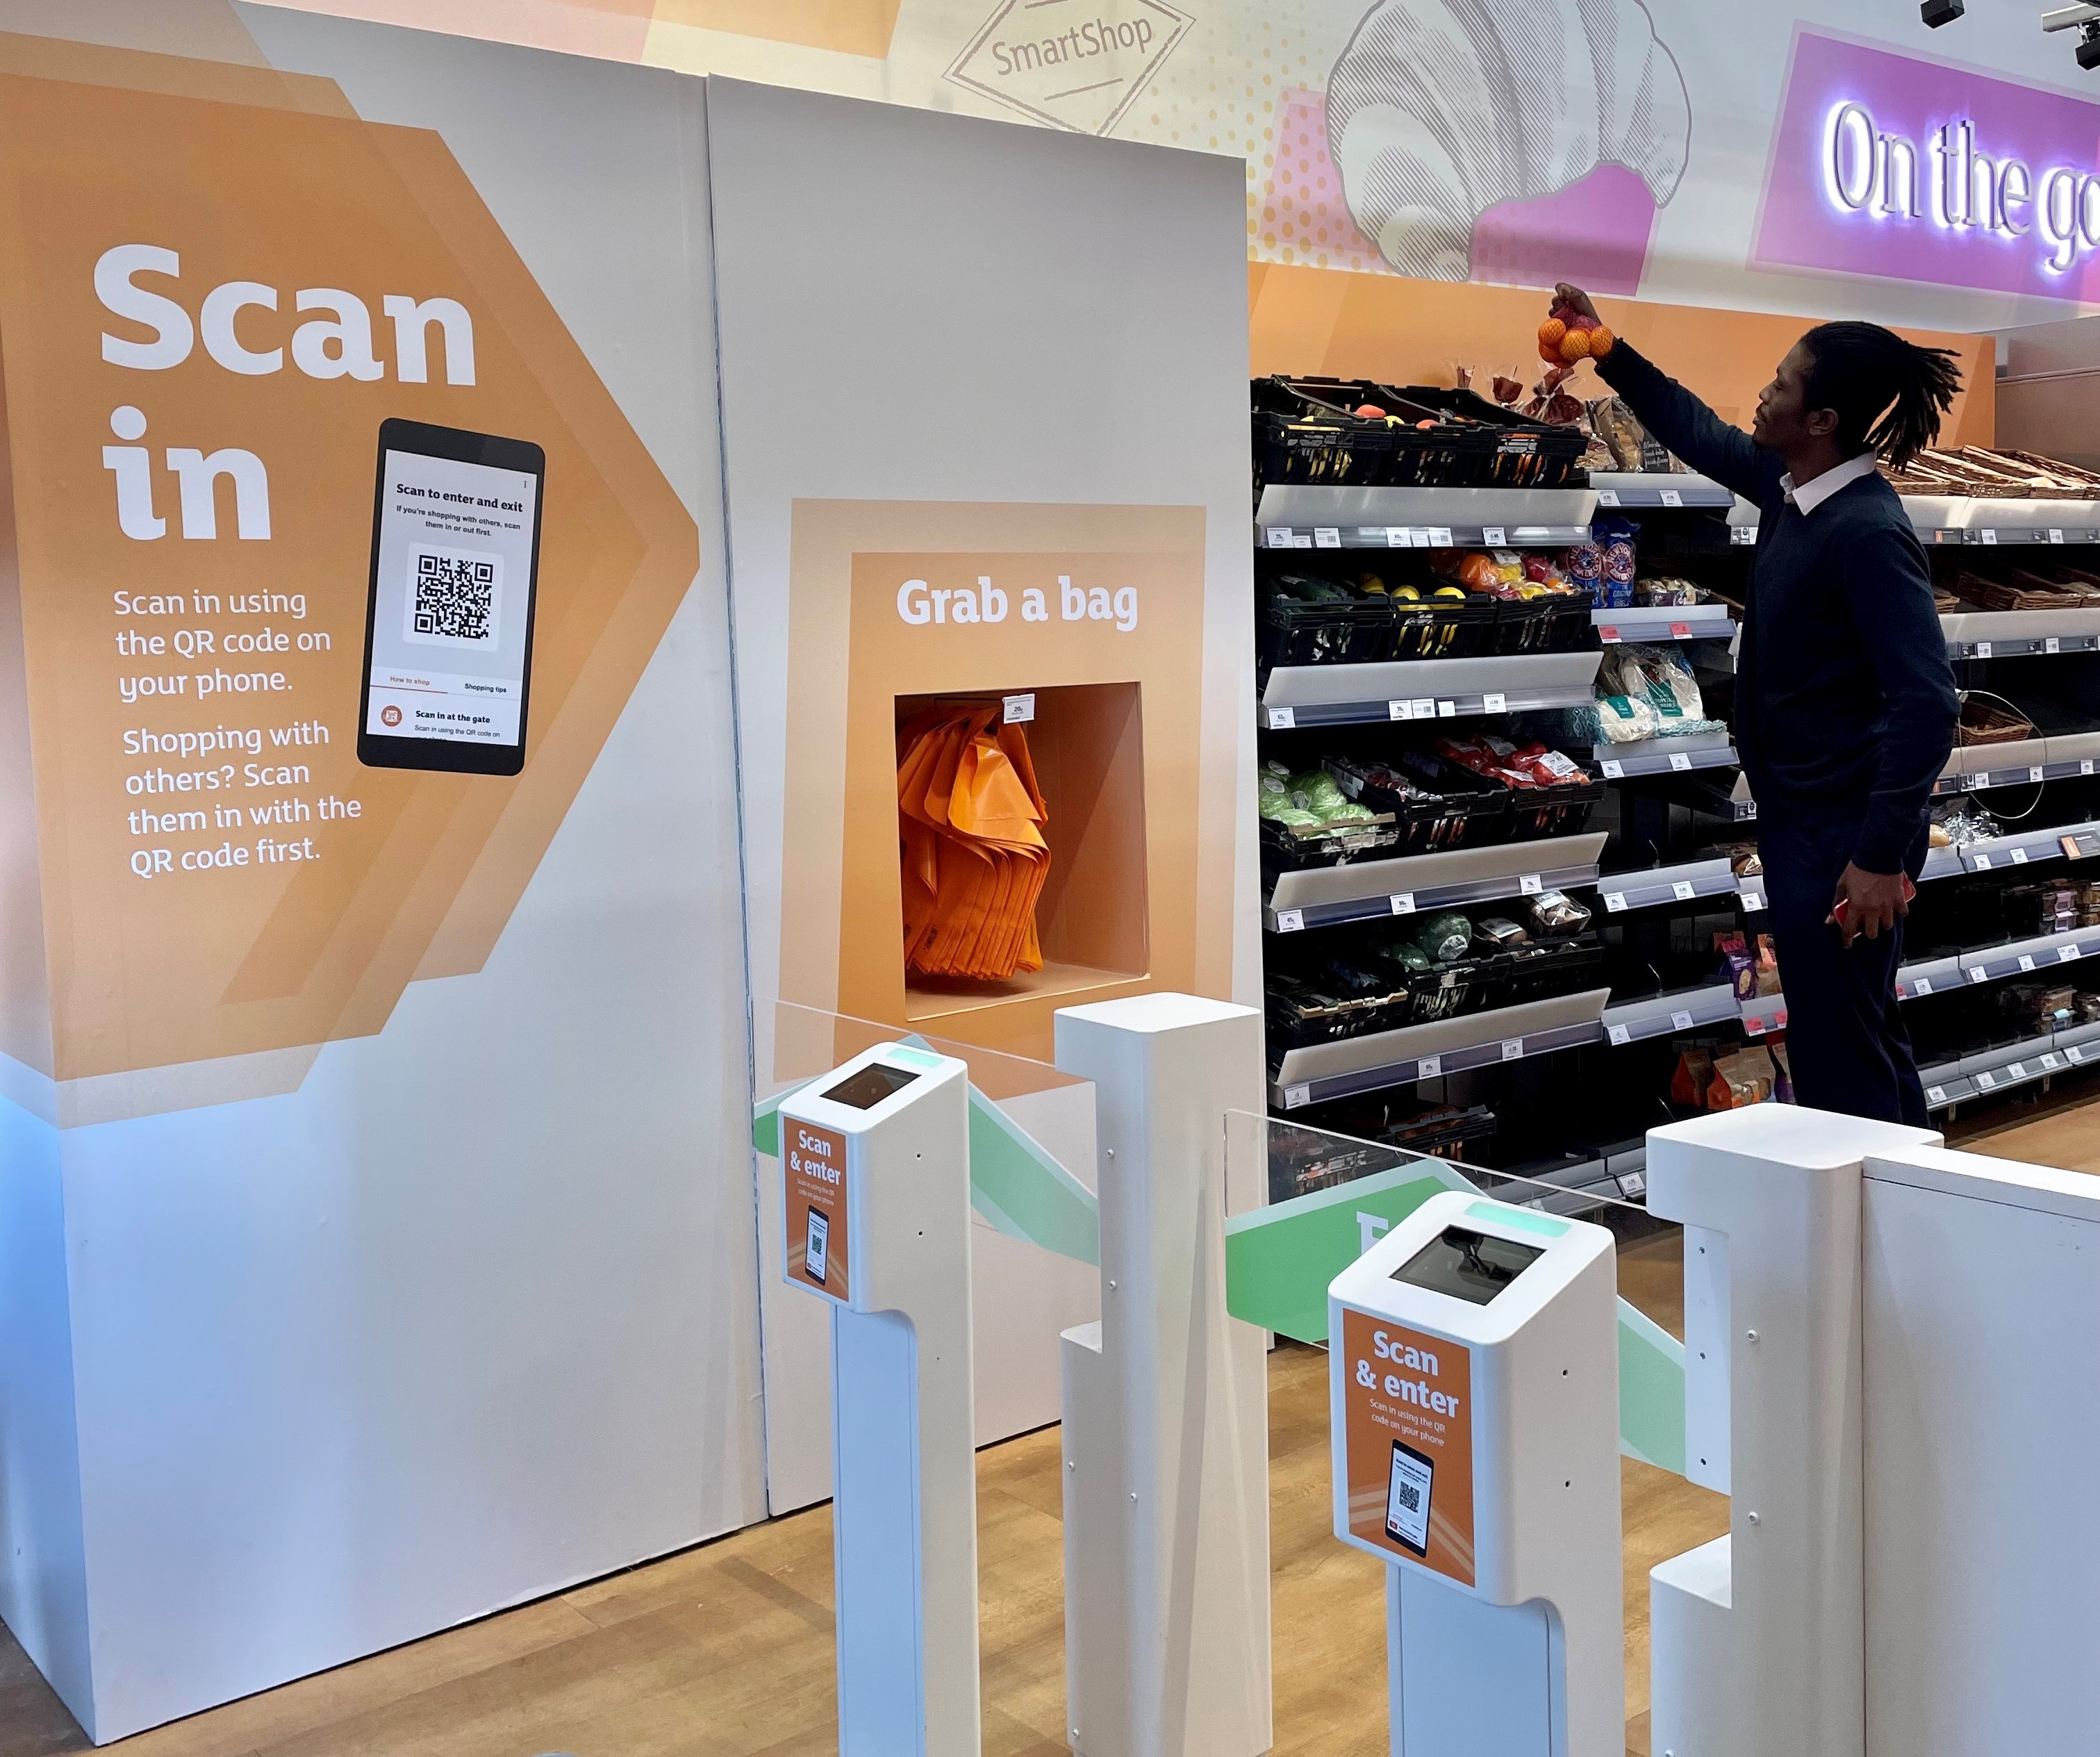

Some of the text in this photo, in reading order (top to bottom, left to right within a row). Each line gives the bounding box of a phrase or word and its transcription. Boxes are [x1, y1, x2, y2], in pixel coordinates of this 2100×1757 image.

[992, 18, 1152, 76] SmartShop
[1830, 101, 1921, 217] On
[1934, 119, 2033, 236] the
[93, 244, 476, 386] Scan
[102, 405, 271, 541] in
[396, 484, 523, 512] Scan to enter and exit
[403, 507, 425, 515] you're
[428, 510, 461, 522] shopping
[479, 518, 502, 527] others,
[425, 521, 443, 529] them
[113, 588, 307, 620] Scan in using
[897, 575, 1138, 632] Grab a bag
[115, 627, 331, 659] the QR code on
[119, 668, 293, 704] your phone.
[414, 677, 430, 686] shop
[465, 683, 494, 693] Shopping
[415, 710, 435, 719] Scan
[437, 711, 445, 720] in
[458, 713, 471, 721] the
[123, 720, 329, 758] Shopping with
[125, 763, 310, 795] others? Scan
[127, 795, 361, 835] them in with the
[130, 837, 321, 879] QR code first.
[799, 1129, 832, 1158] Scan
[790, 1150, 841, 1186] & enter
[1373, 1330, 1439, 1377] Scan
[1356, 1359, 1459, 1419] & enter
[1369, 1398, 1446, 1433] Scan in using the QR
[1371, 1413, 1445, 1446] code on your phone
